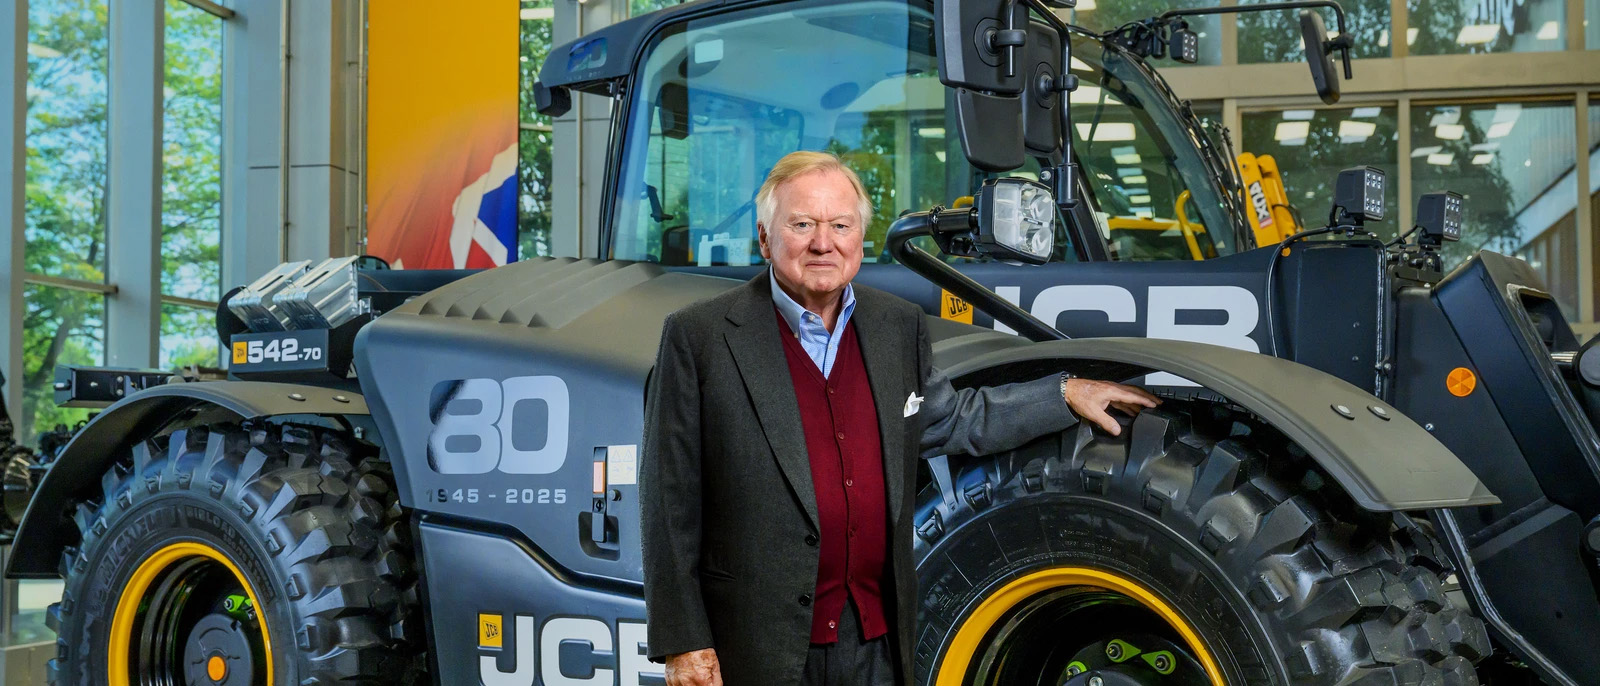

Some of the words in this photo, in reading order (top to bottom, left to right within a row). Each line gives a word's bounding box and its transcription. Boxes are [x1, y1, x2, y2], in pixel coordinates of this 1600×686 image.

[950, 297, 968, 315] JCB
[427, 375, 570, 474] 80
[426, 488, 479, 503] 1945
[505, 488, 567, 504] 2025
[486, 622, 499, 638] JCB
